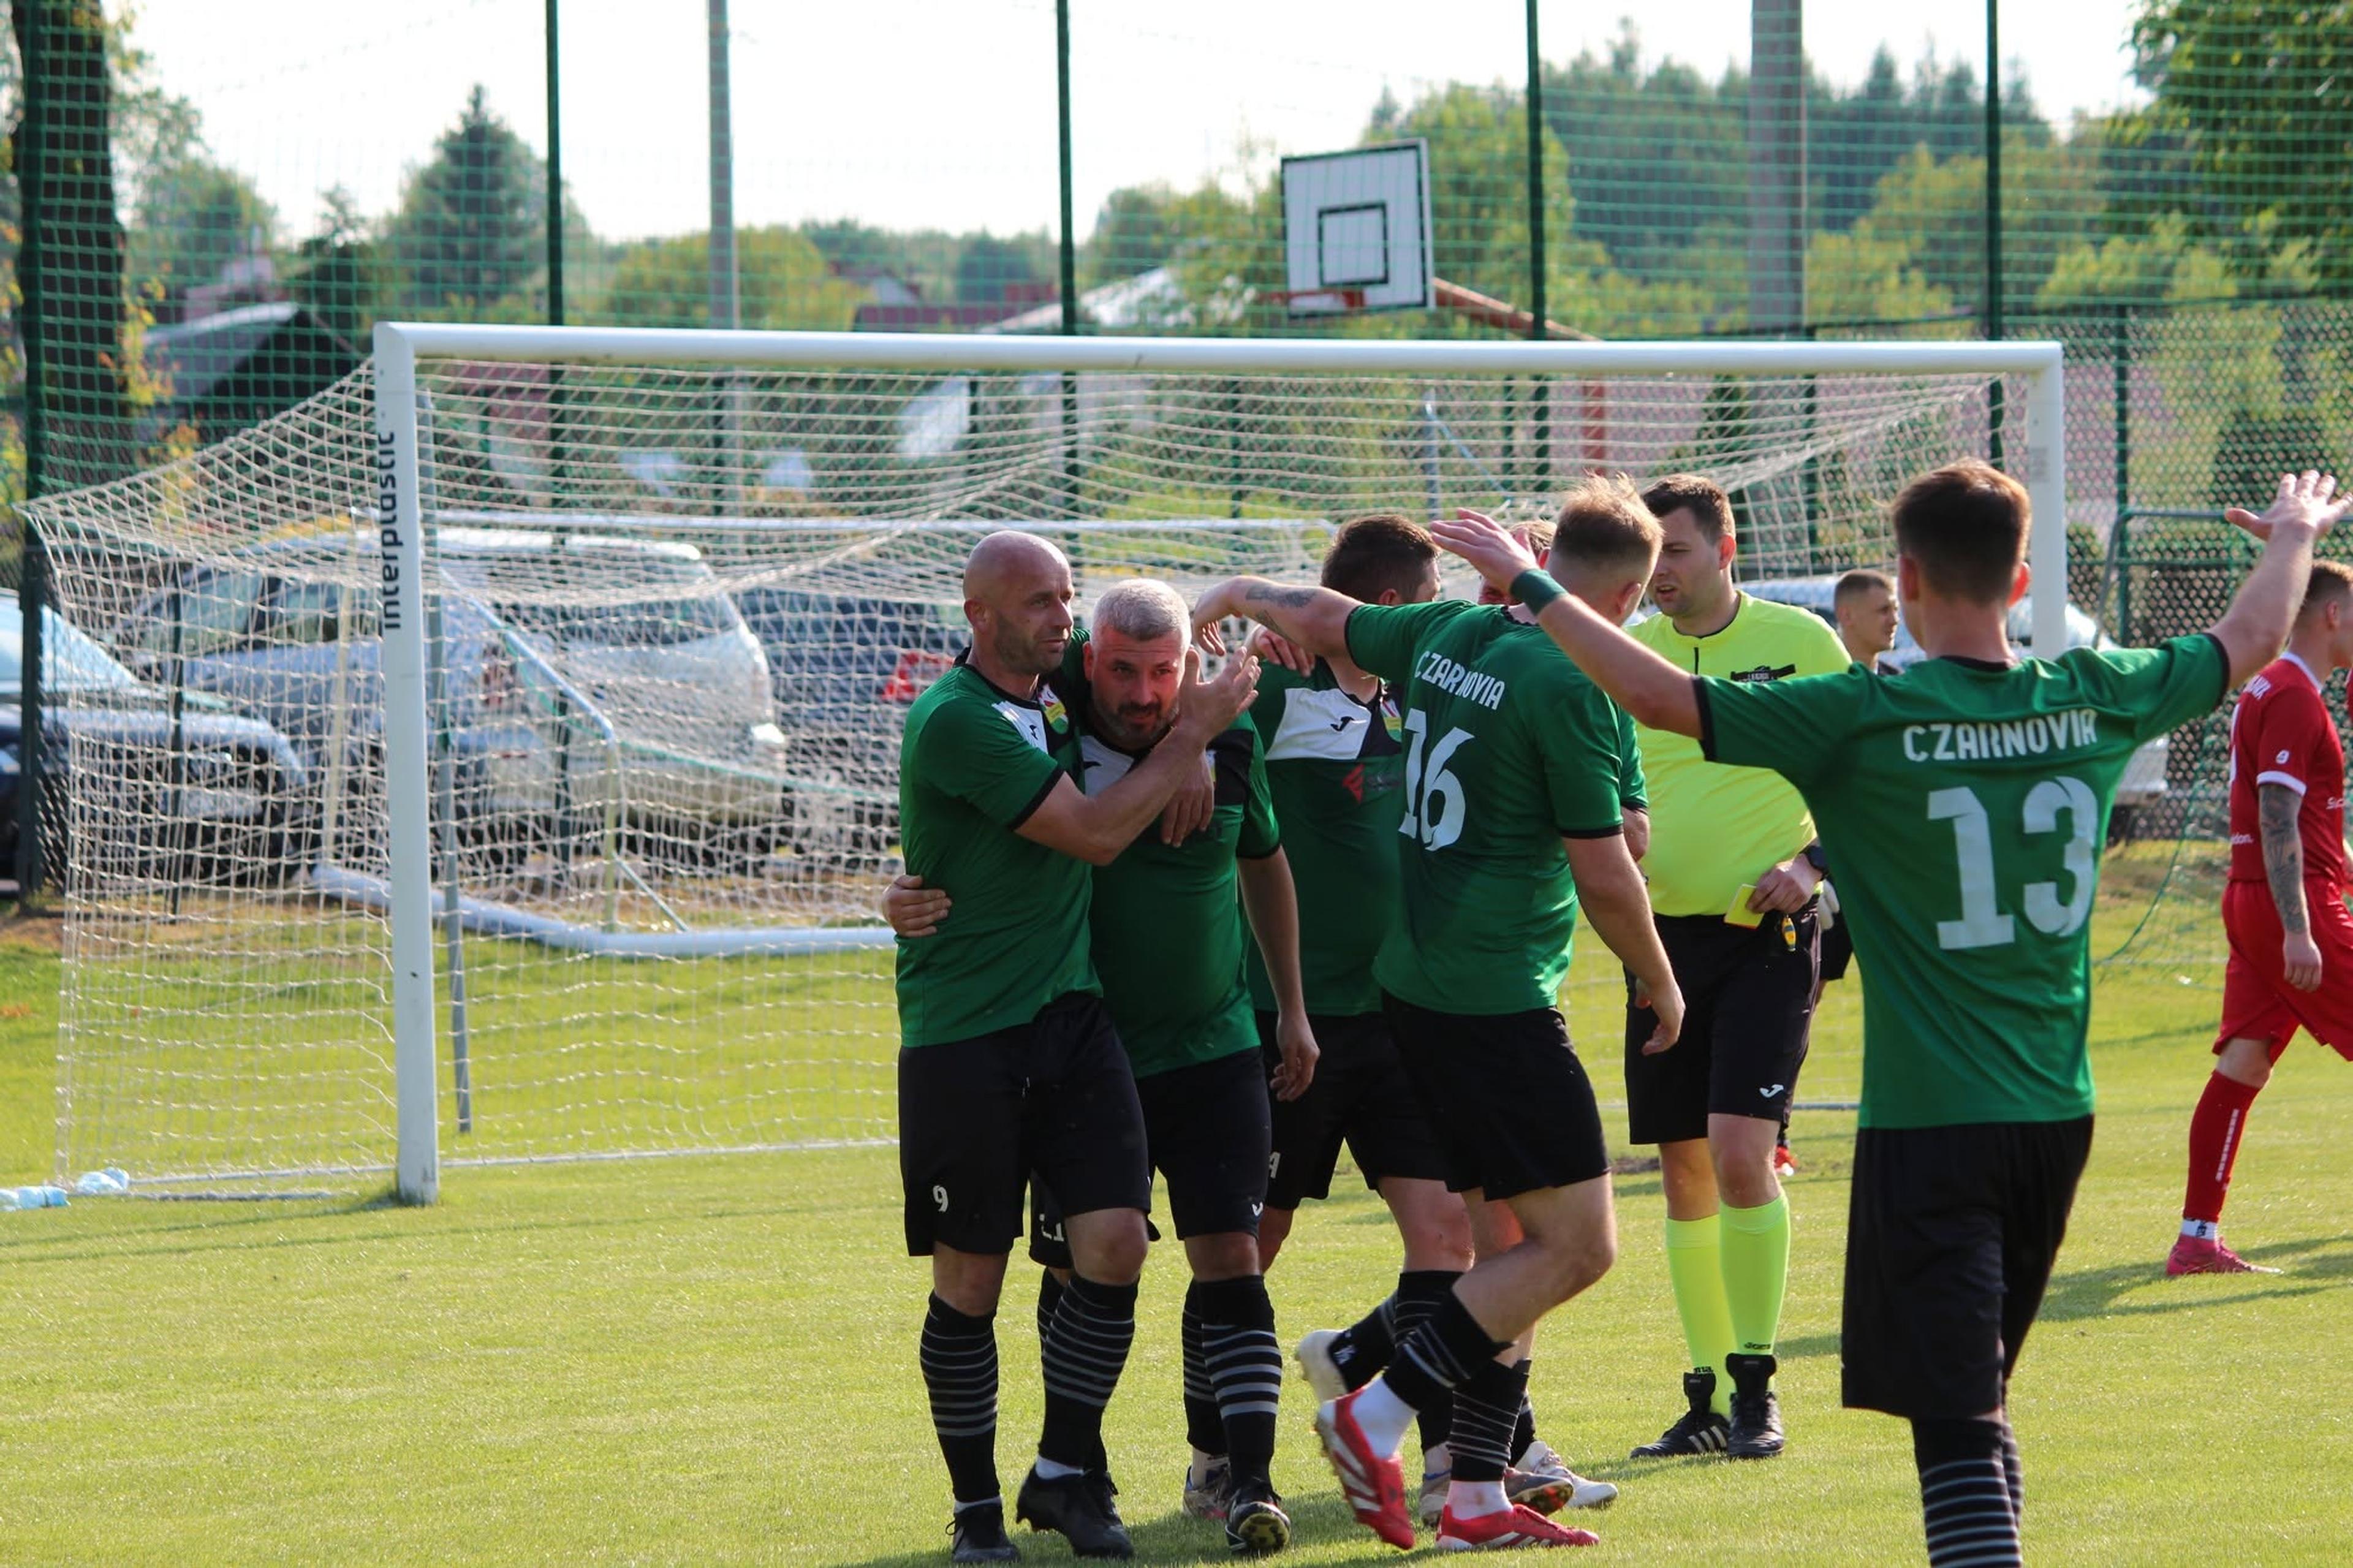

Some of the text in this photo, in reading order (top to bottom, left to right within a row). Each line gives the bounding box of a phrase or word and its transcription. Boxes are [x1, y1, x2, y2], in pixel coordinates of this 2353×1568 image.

[377, 431, 404, 629] interplastic
[1398, 707, 1475, 852] 16
[1902, 708, 2098, 762] CZARNOVIA
[1927, 775, 2099, 950] 13
[932, 1185, 949, 1213] 9
